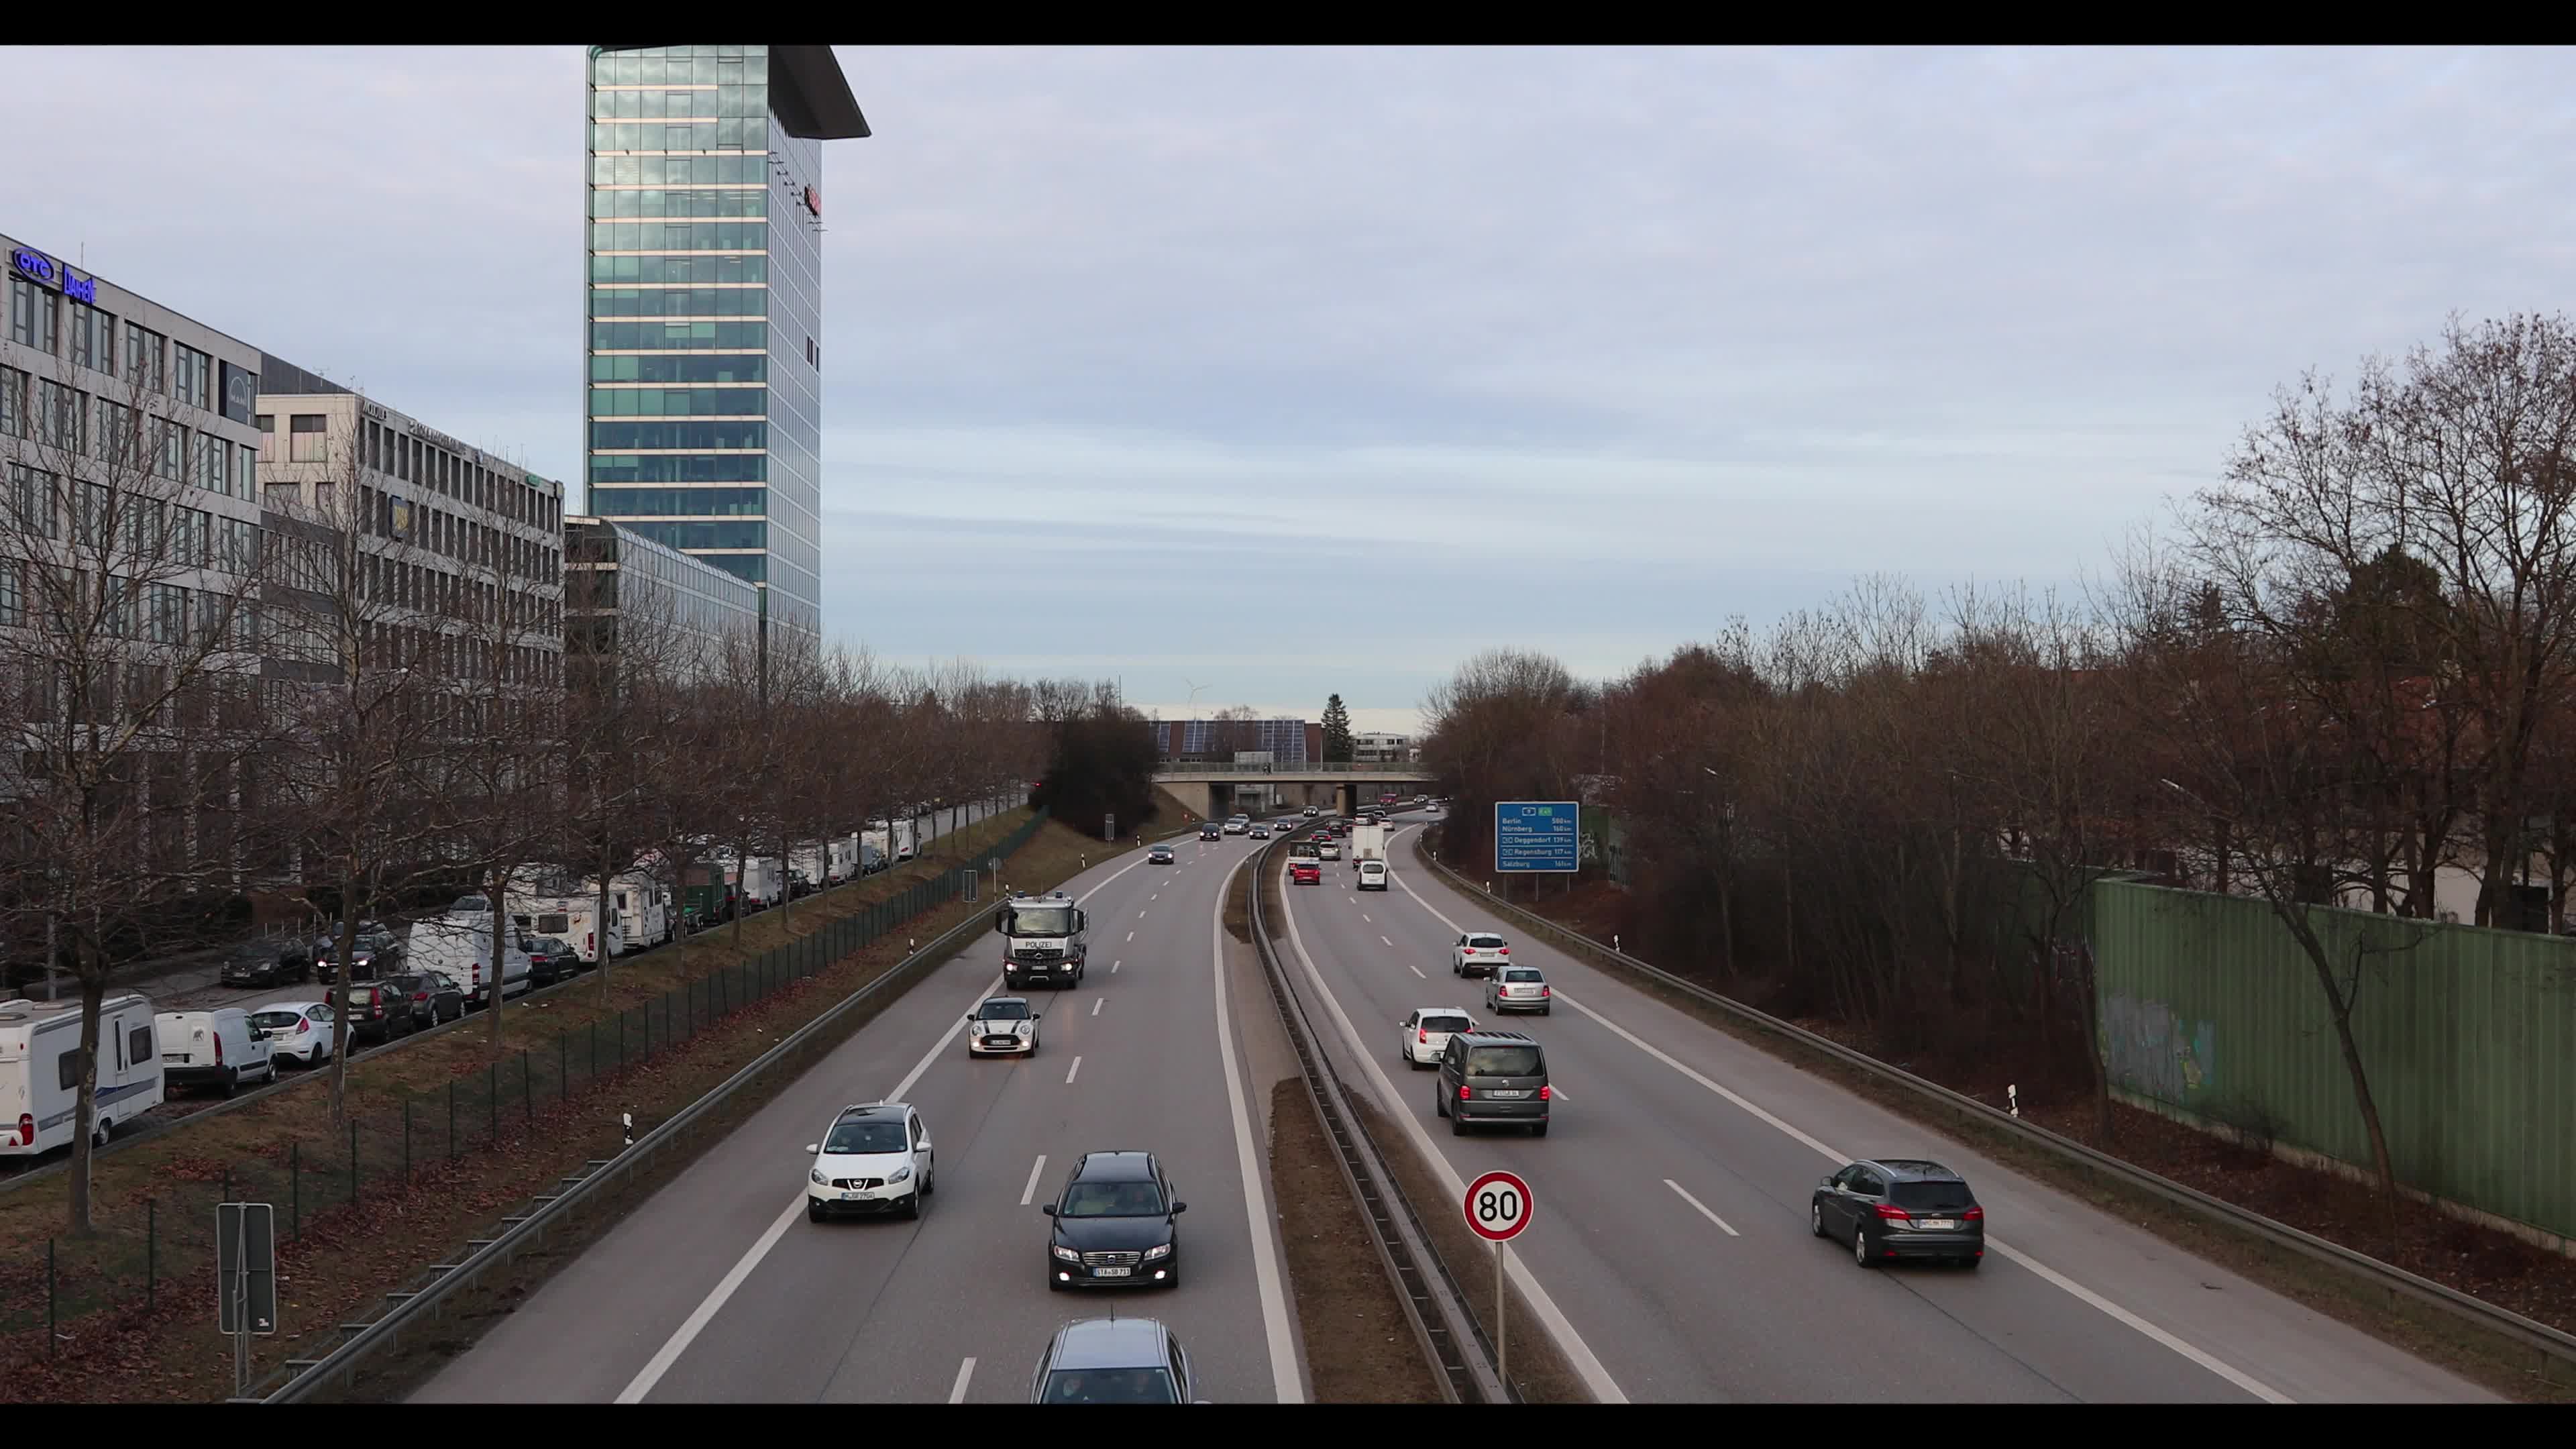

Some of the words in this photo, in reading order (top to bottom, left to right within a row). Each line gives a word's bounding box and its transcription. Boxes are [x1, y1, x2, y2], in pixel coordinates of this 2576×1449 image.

[20, 253, 51, 277] OTC
[1514, 837, 1551, 845] Deggendorf
[1514, 848, 1552, 856] Regensburg
[1502, 860, 1530, 868] Salzburg
[1479, 1191, 1517, 1222] 80
